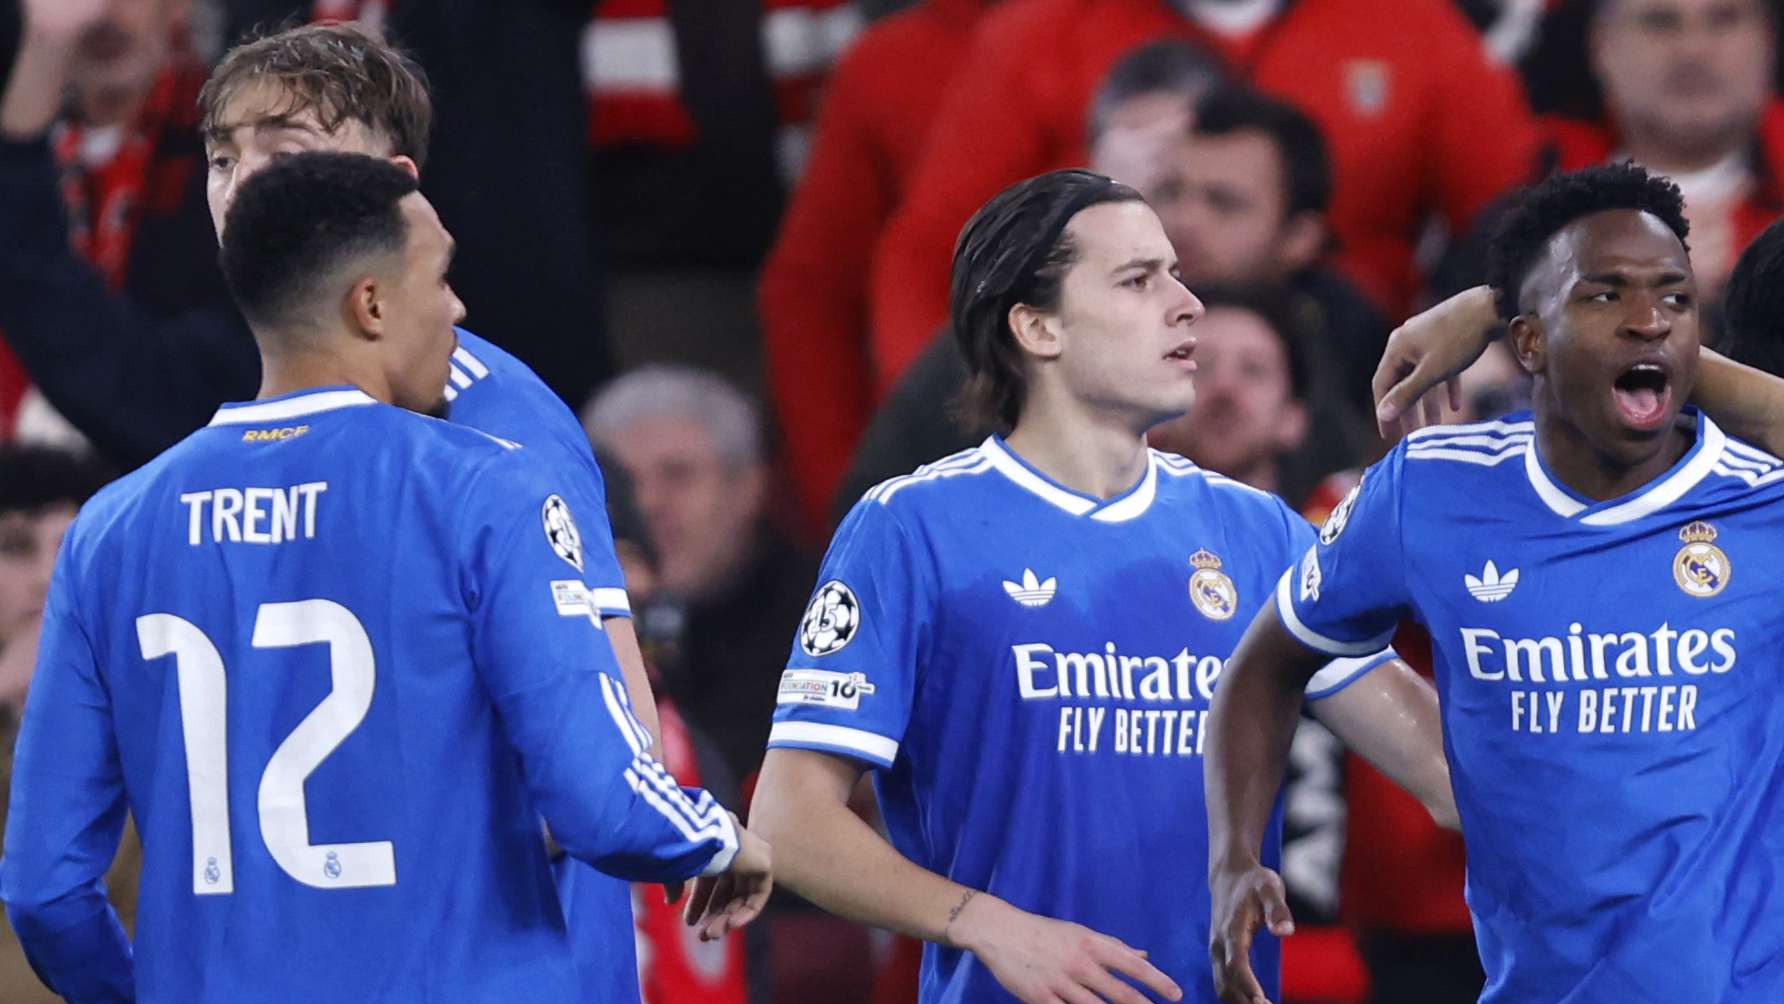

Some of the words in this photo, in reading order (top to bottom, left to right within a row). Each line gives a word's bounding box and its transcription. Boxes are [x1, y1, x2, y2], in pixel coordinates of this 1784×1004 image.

[242, 424, 310, 441] RMCF
[180, 481, 328, 546] TRENT
[1011, 641, 1230, 701] Emirate
[1459, 621, 1737, 683] Emirates
[832, 680, 857, 699] 10
[1511, 691, 1564, 733] FLY
[1577, 684, 1698, 734] BETTER
[136, 598, 397, 895] 12
[1057, 706, 1106, 753] FLY
